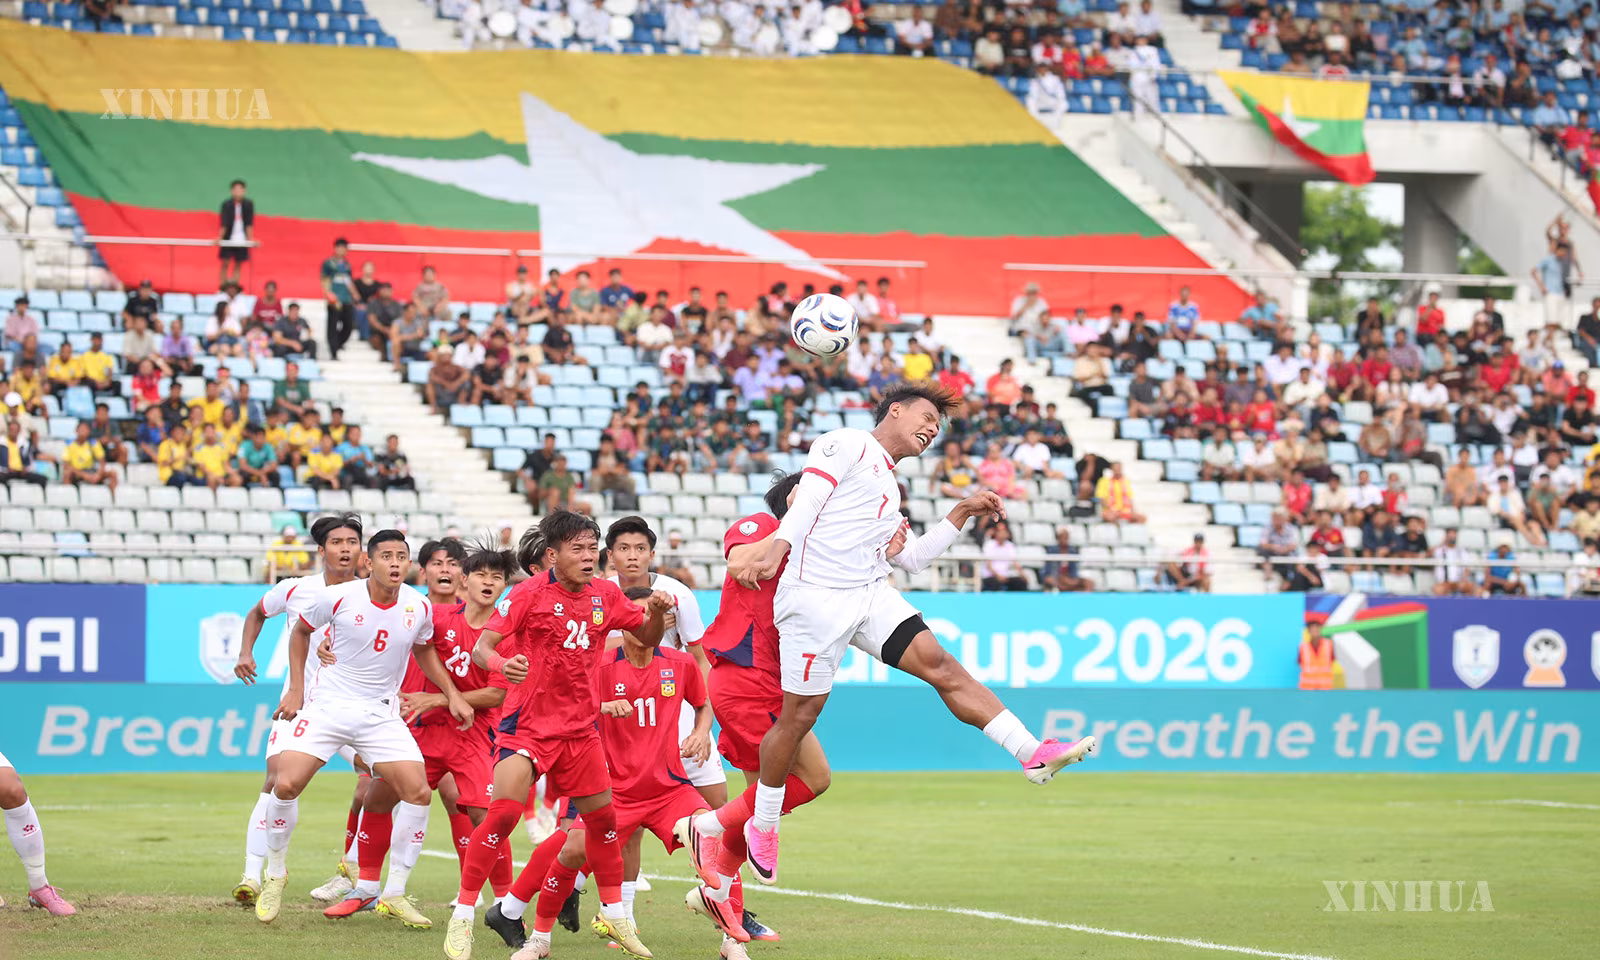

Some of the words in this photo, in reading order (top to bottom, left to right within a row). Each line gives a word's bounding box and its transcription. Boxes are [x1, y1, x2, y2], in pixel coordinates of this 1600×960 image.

[876, 493, 889, 519] 7
[373, 629, 389, 652] 6
[563, 619, 590, 650] 24
[444, 645, 471, 678] 23
[802, 652, 817, 682] 7
[921, 617, 1063, 687] up
[1073, 617, 1254, 682] 2026
[633, 697, 657, 727] 11
[293, 719, 309, 738] 6
[1041, 708, 1315, 759] Breathe
[1333, 707, 1443, 759] the
[1454, 708, 1582, 763] Win
